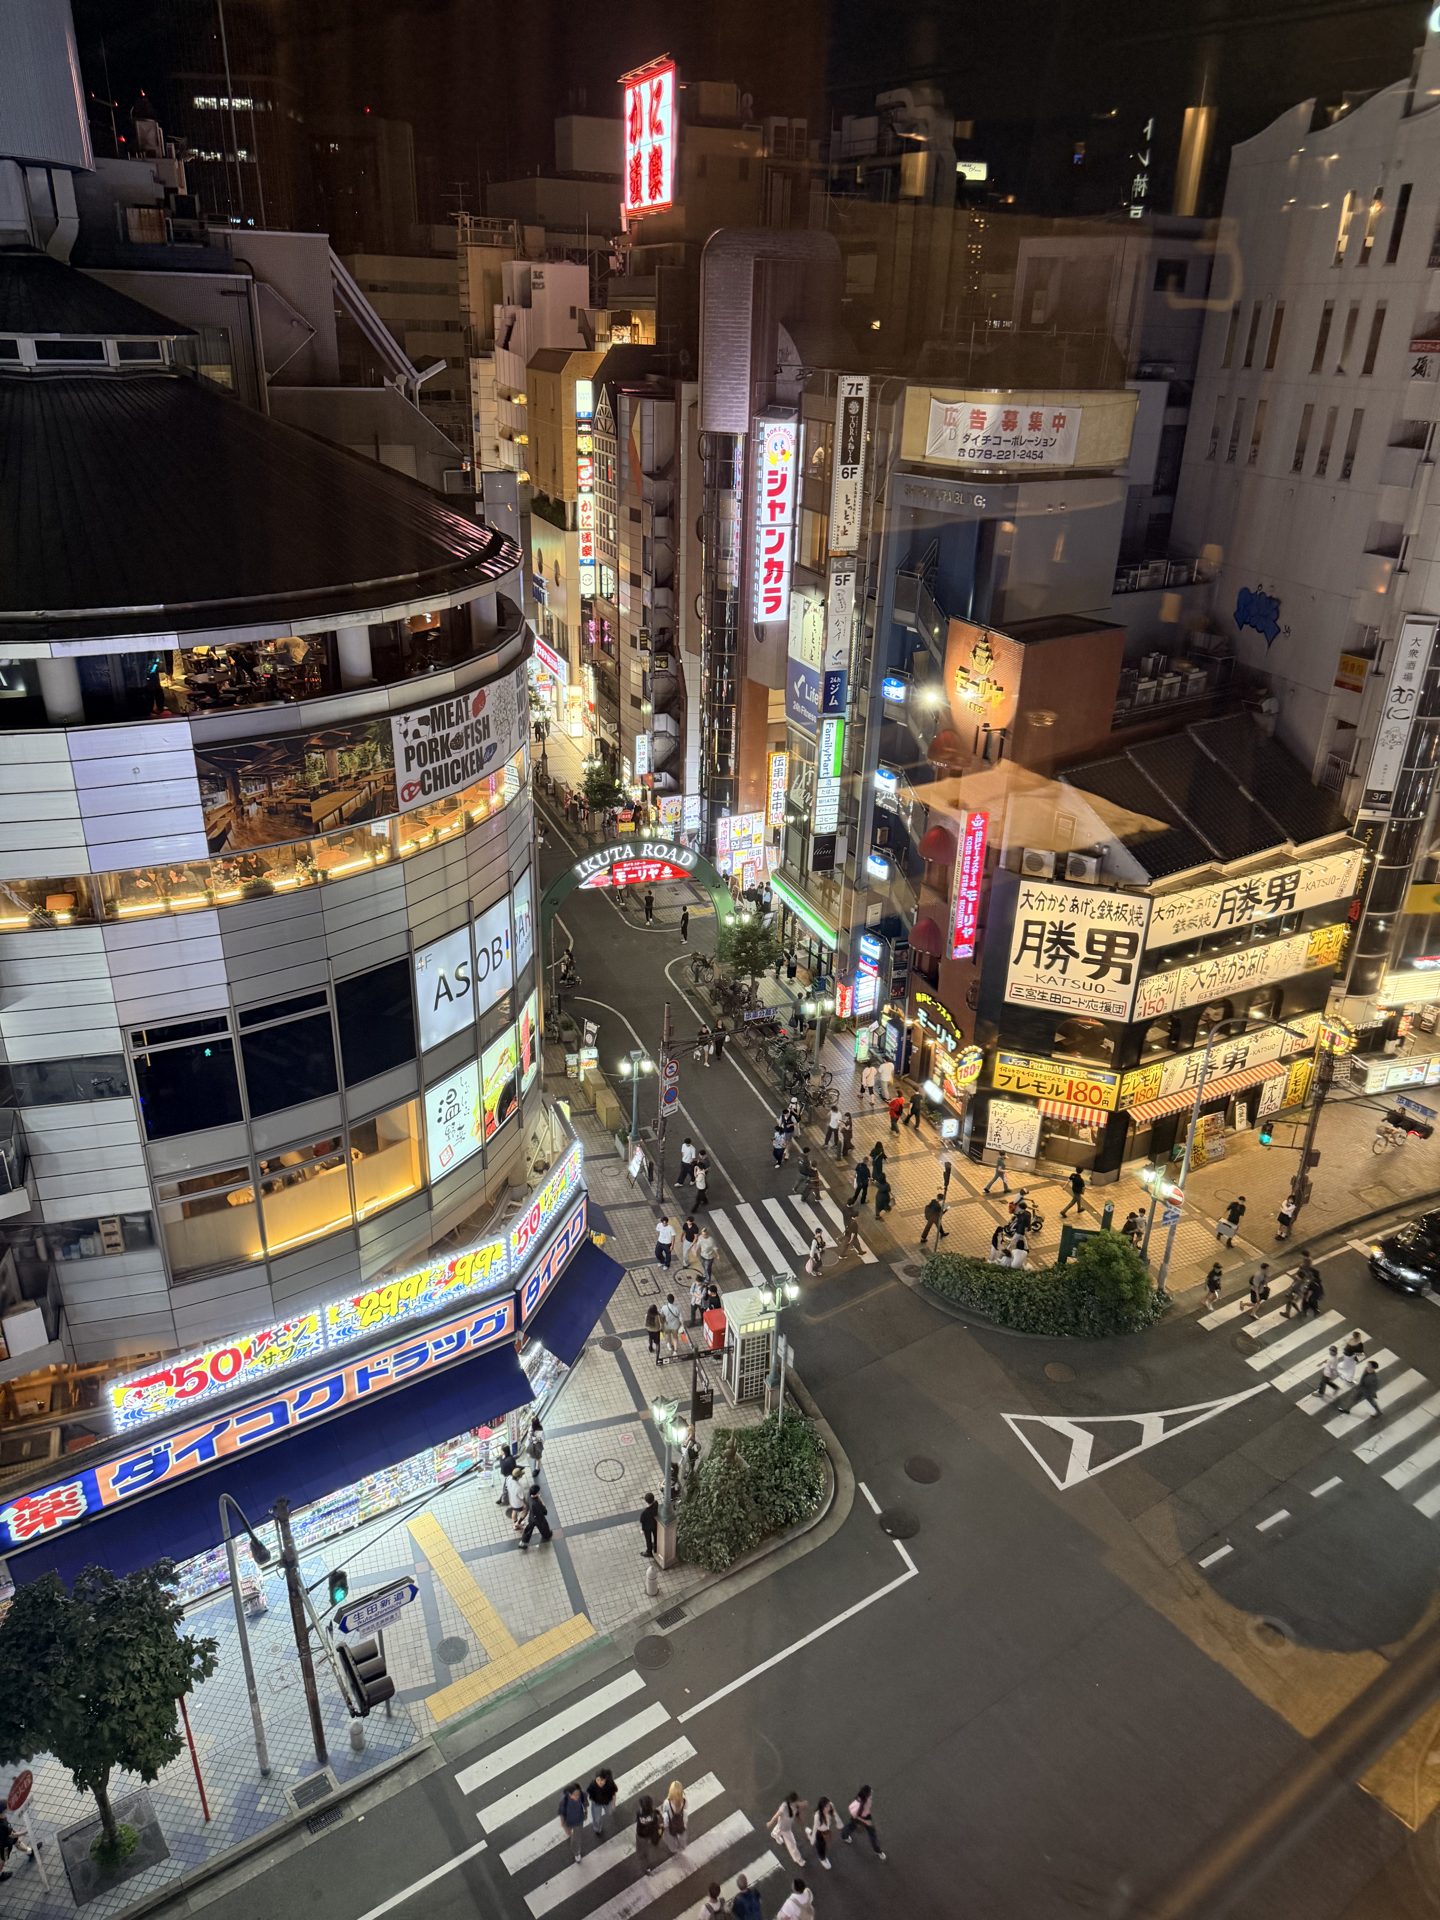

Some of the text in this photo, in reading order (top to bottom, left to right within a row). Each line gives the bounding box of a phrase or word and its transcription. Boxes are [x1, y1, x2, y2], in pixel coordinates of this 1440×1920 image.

[847, 383, 864, 395] 7F
[943, 406, 1067, 433] 広告募集中
[962, 434, 1057, 447] ダイチコーポレーション
[968, 448, 1044, 460] 078-221-2454
[841, 467, 858, 479] 6F
[580, 500, 593, 557] かに道楽
[763, 467, 788, 615] ジャンカラ
[833, 561, 854, 569] KE
[835, 575, 850, 586] 5F
[1402, 637, 1422, 682] 大衆酒場
[829, 685, 839, 706] ジム
[430, 696, 471, 734] MEAT
[404, 715, 491, 773] PORK FISH
[821, 722, 834, 777] FamilyMart
[420, 746, 485, 796] CHICKEN
[1372, 792, 1387, 801] 3F
[575, 843, 693, 878] IKUTA ROAD
[616, 868, 661, 882] モーリヤ
[962, 890, 978, 938] モーリヤ
[1019, 889, 1145, 927] 大分からあげと鉄板焼
[1212, 869, 1302, 929] 勝男
[416, 953, 433, 972] 4F
[1012, 919, 1139, 986] 勝男
[1011, 986, 1125, 1015] 三宮生田ロード応援団
[1137, 980, 1176, 1004] ハイボール
[1142, 997, 1165, 1017] 150
[916, 992, 961, 1039] 神戸ビーフステーキ
[917, 1007, 957, 1053] モーリヤ
[998, 1073, 1065, 1097] プレモル
[1029, 1060, 1088, 1080] PREMIUM BEER
[1121, 1072, 1160, 1094] プレモル
[1066, 1080, 1103, 1105] 180
[516, 1202, 541, 1256] 50
[454, 1246, 497, 1287] 99
[525, 1205, 585, 1315] ダイコク
[358, 1273, 423, 1328] 299
[251, 1320, 312, 1359] レモン
[260, 1342, 314, 1367] サワー
[173, 1348, 243, 1399] 50
[109, 1305, 509, 1498] ダイコクドラッグ
[12, 1481, 84, 1538] 薬
[353, 1590, 405, 1623] 生田新道
